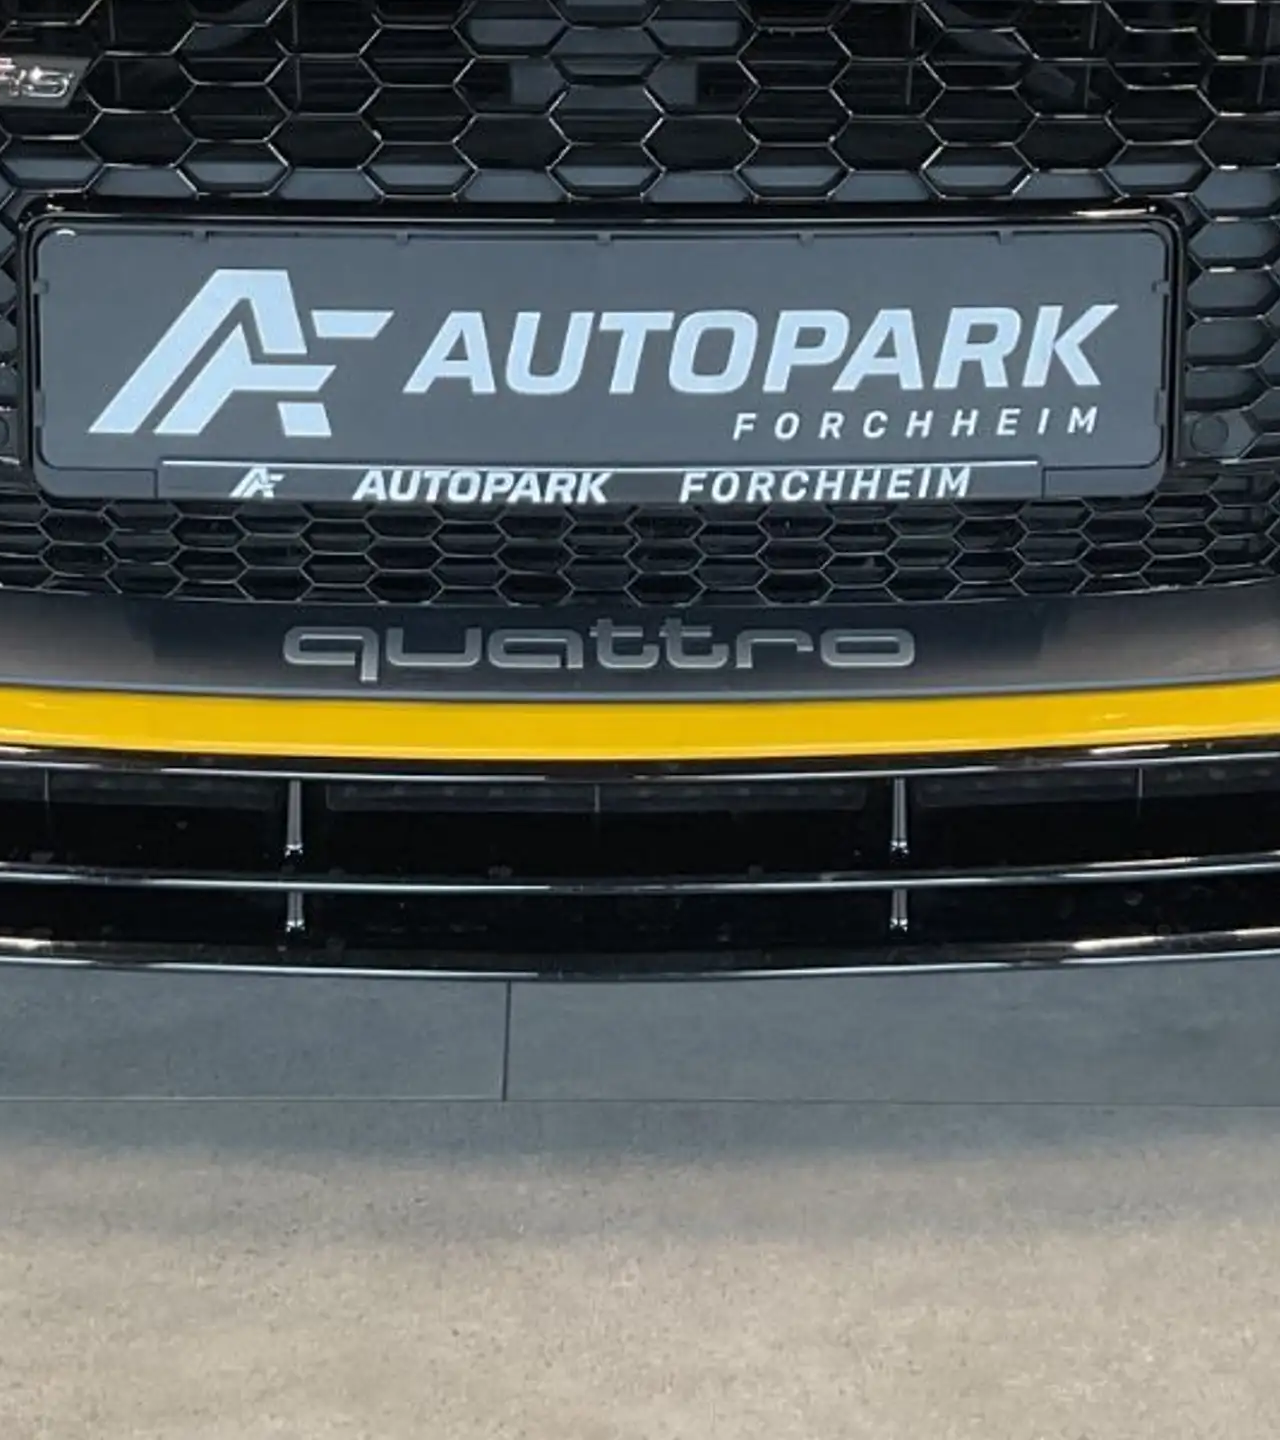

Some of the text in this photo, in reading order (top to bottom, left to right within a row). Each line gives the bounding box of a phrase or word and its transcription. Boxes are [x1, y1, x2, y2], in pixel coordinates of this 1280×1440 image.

[402, 303, 1118, 396] AUTOPARK
[731, 406, 1098, 442] FORCHHEIM
[352, 469, 612, 504] AUTOPARK
[679, 466, 972, 503] FORCHHEIM
[282, 618, 916, 682] quattro
